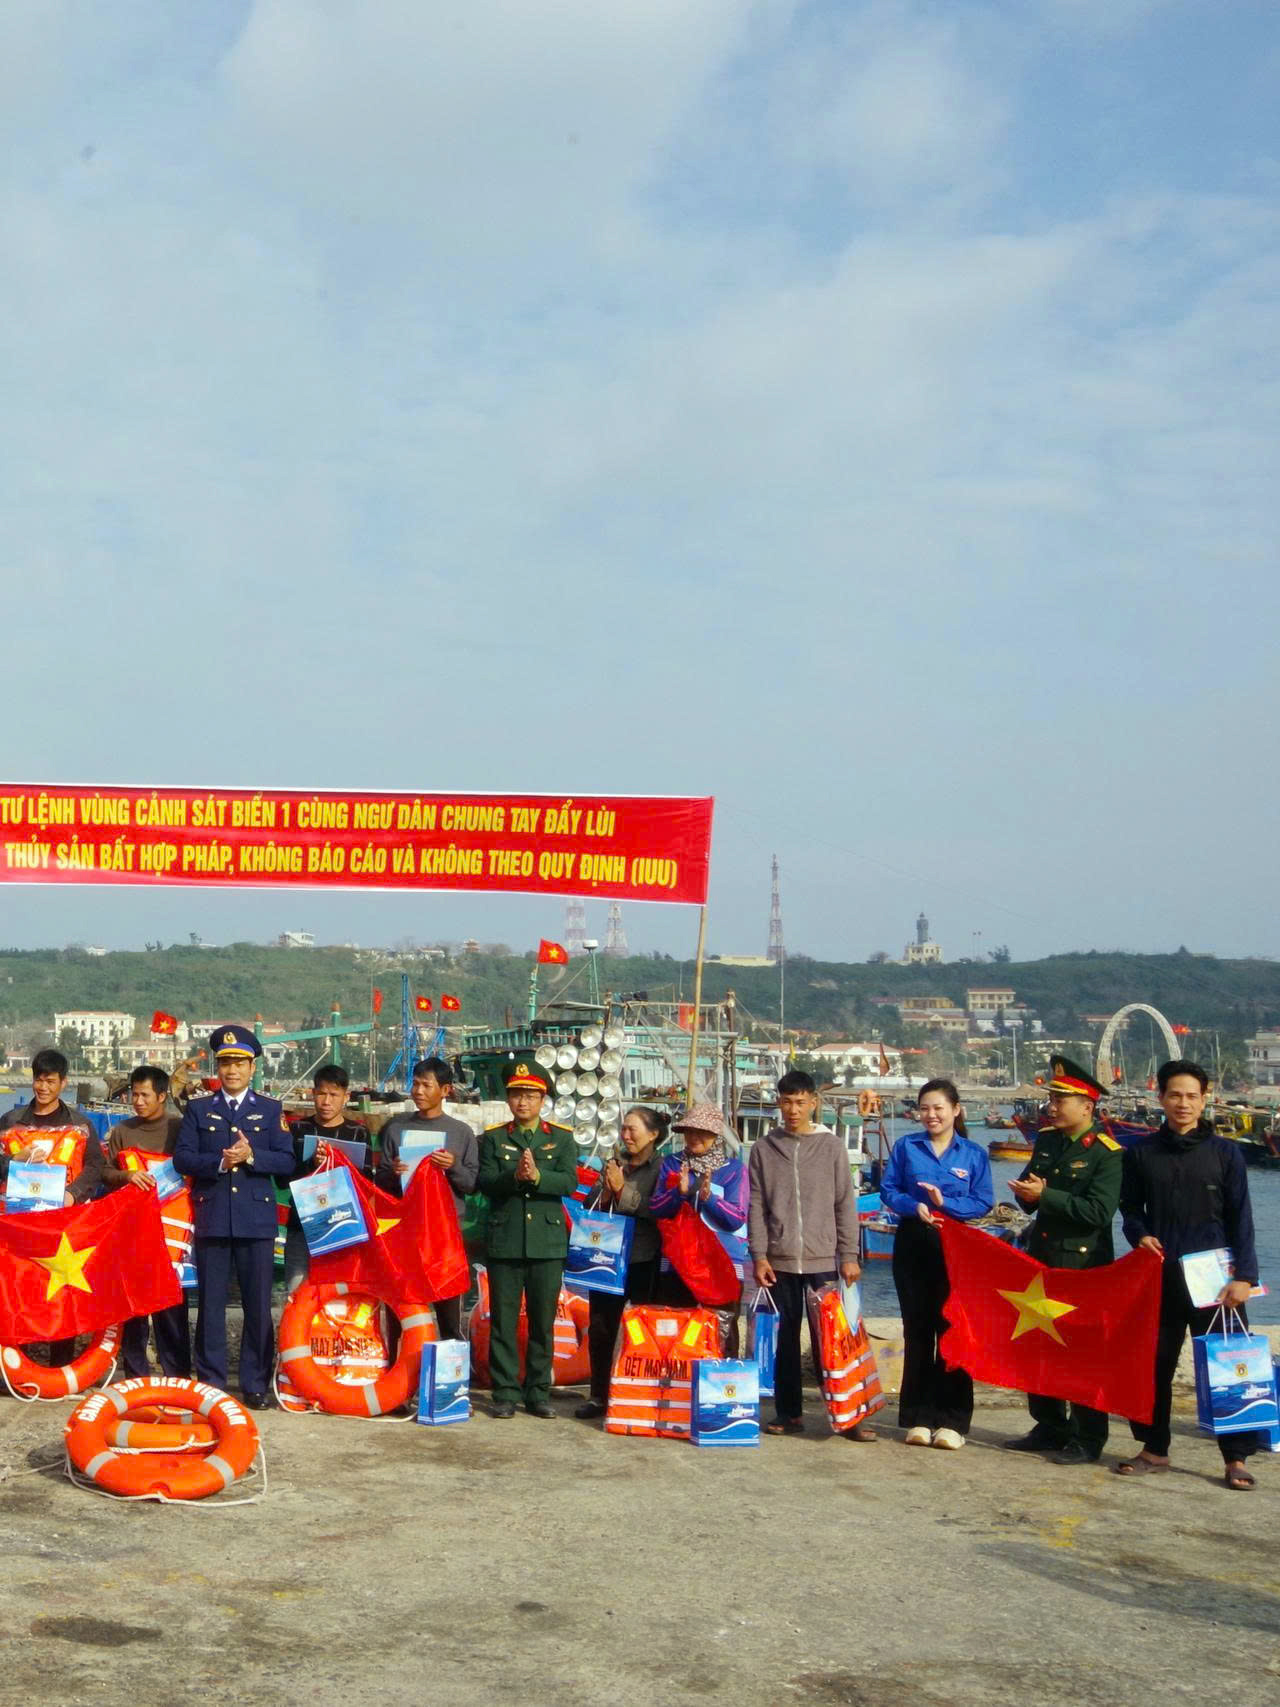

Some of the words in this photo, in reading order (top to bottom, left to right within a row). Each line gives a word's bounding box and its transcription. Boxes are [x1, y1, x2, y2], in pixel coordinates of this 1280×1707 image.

[0, 795, 25, 824] TƯ
[28, 792, 75, 830] LỆNH
[80, 792, 130, 825] VÙNG
[135, 791, 186, 826] CẢNH
[192, 794, 227, 827] SÁT
[231, 792, 275, 827] BIỂN
[281, 801, 290, 827] 1
[297, 796, 349, 829] CÙNG
[354, 801, 395, 829] NGƯ
[397, 799, 437, 829] DÂN
[441, 805, 505, 832] CHUNG
[511, 807, 541, 832] TAY
[544, 799, 582, 835] ĐẨY
[585, 805, 616, 837] LÙI
[4, 834, 51, 869] THỦY
[56, 834, 95, 870] SẢN
[100, 834, 136, 872] BẤT
[140, 842, 177, 877] HỢP
[183, 840, 235, 875] PHÁP,
[240, 841, 303, 873] KHÔNG
[308, 840, 345, 873] BÁO
[350, 842, 387, 873] CÁO
[392, 843, 416, 874] VÀ
[420, 843, 483, 875] KHÔNG
[488, 849, 534, 877] THEO
[538, 851, 576, 880] QUY
[579, 853, 626, 887] ĐỊNH
[631, 857, 678, 888] (IUU)
